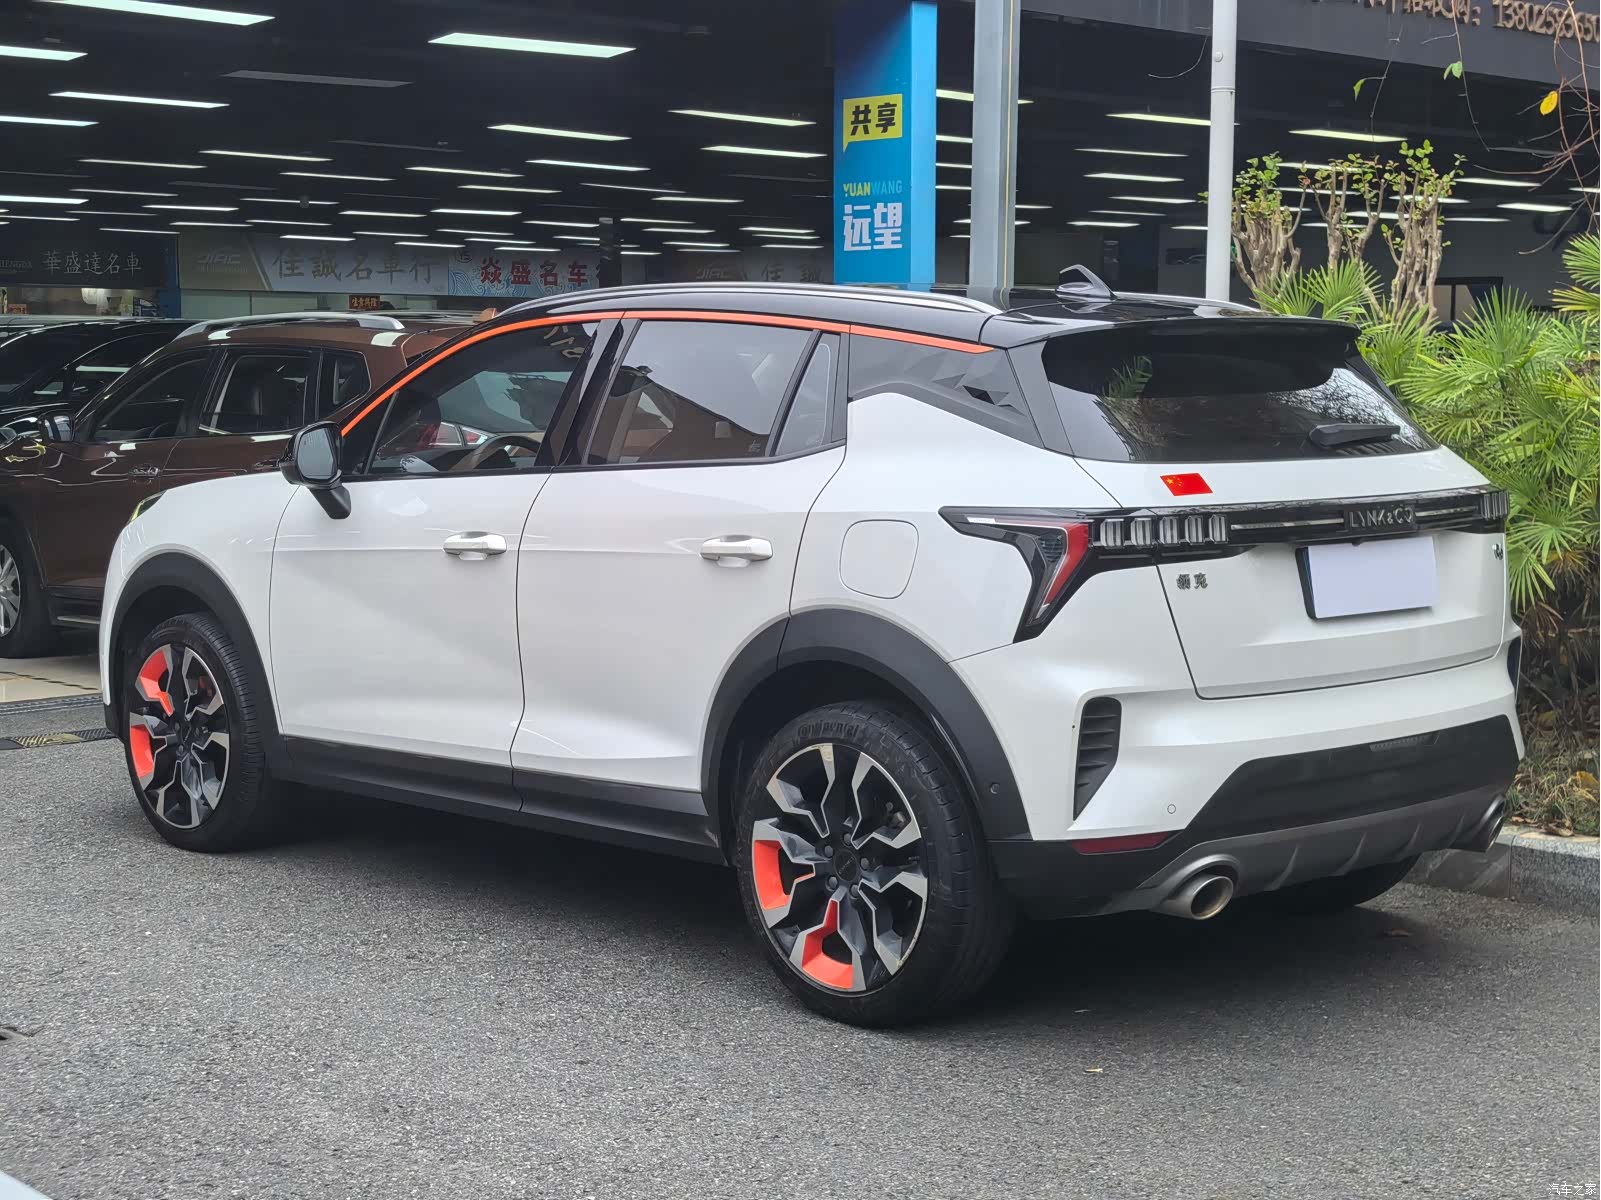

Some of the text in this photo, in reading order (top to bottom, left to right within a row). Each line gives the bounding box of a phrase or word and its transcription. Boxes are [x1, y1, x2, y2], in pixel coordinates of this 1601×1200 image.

[850, 102, 897, 136] 共享
[843, 180, 903, 197] YUANWANG
[843, 202, 903, 251] 远望
[42, 249, 142, 277] 華盛達名車
[273, 247, 440, 284] 佳誠名車行
[480, 255, 600, 287] 焱盛名车
[1349, 506, 1414, 528] LYNK&CO
